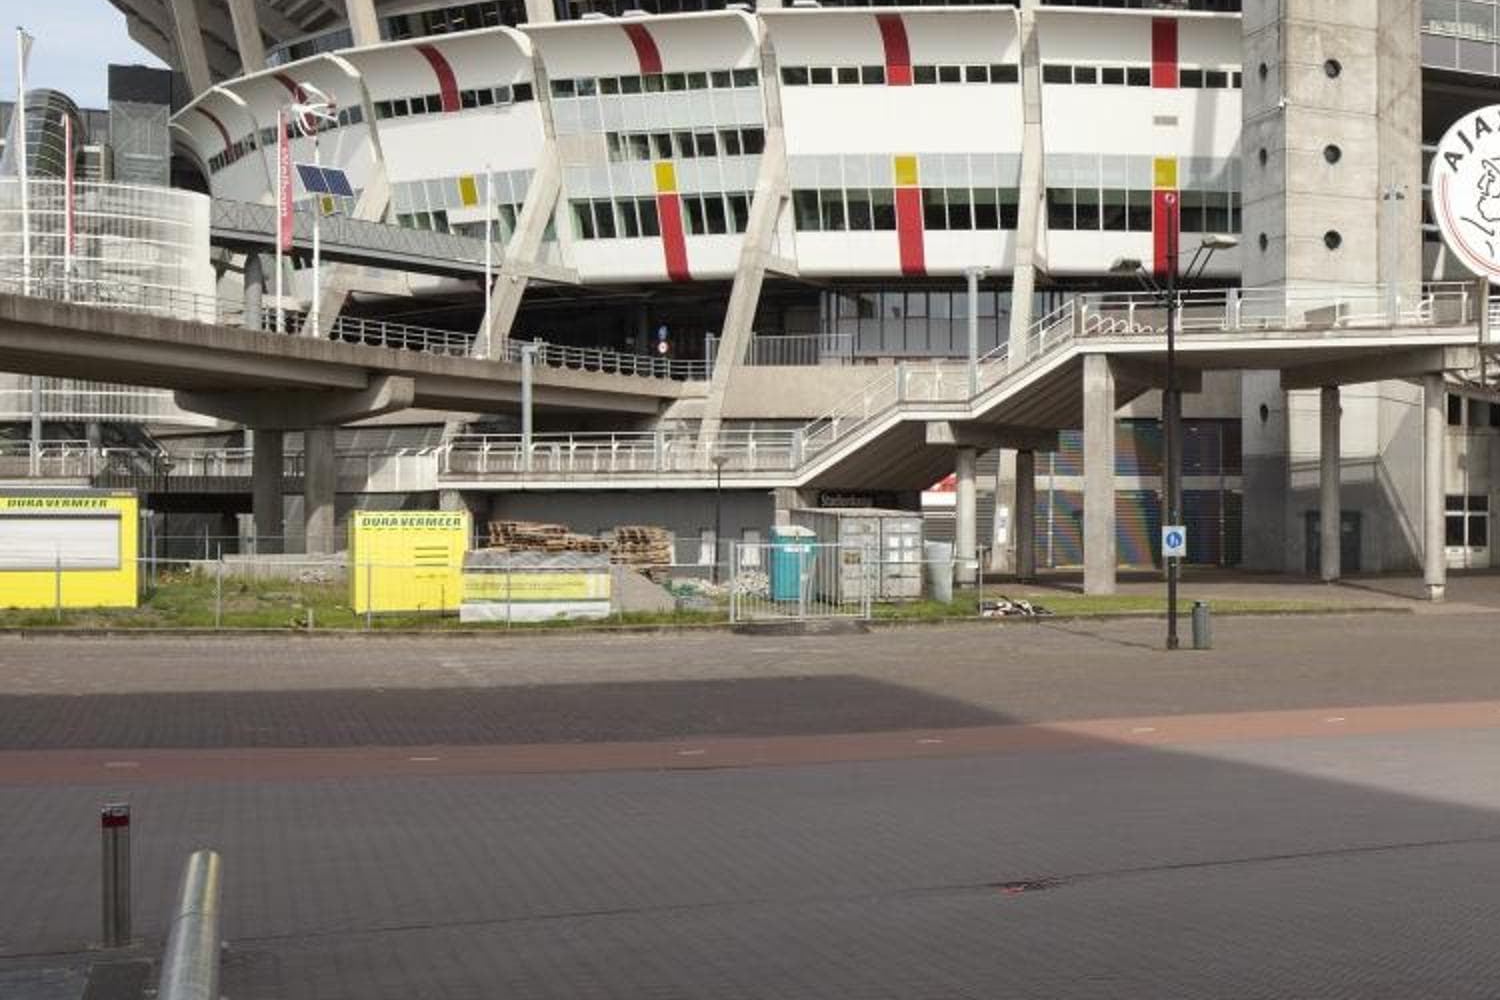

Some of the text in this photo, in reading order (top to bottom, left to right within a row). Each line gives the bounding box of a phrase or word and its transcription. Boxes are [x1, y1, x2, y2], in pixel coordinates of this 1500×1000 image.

[7, 499, 108, 508] DURA VERMEER
[362, 516, 462, 527] DURA VERMEER
